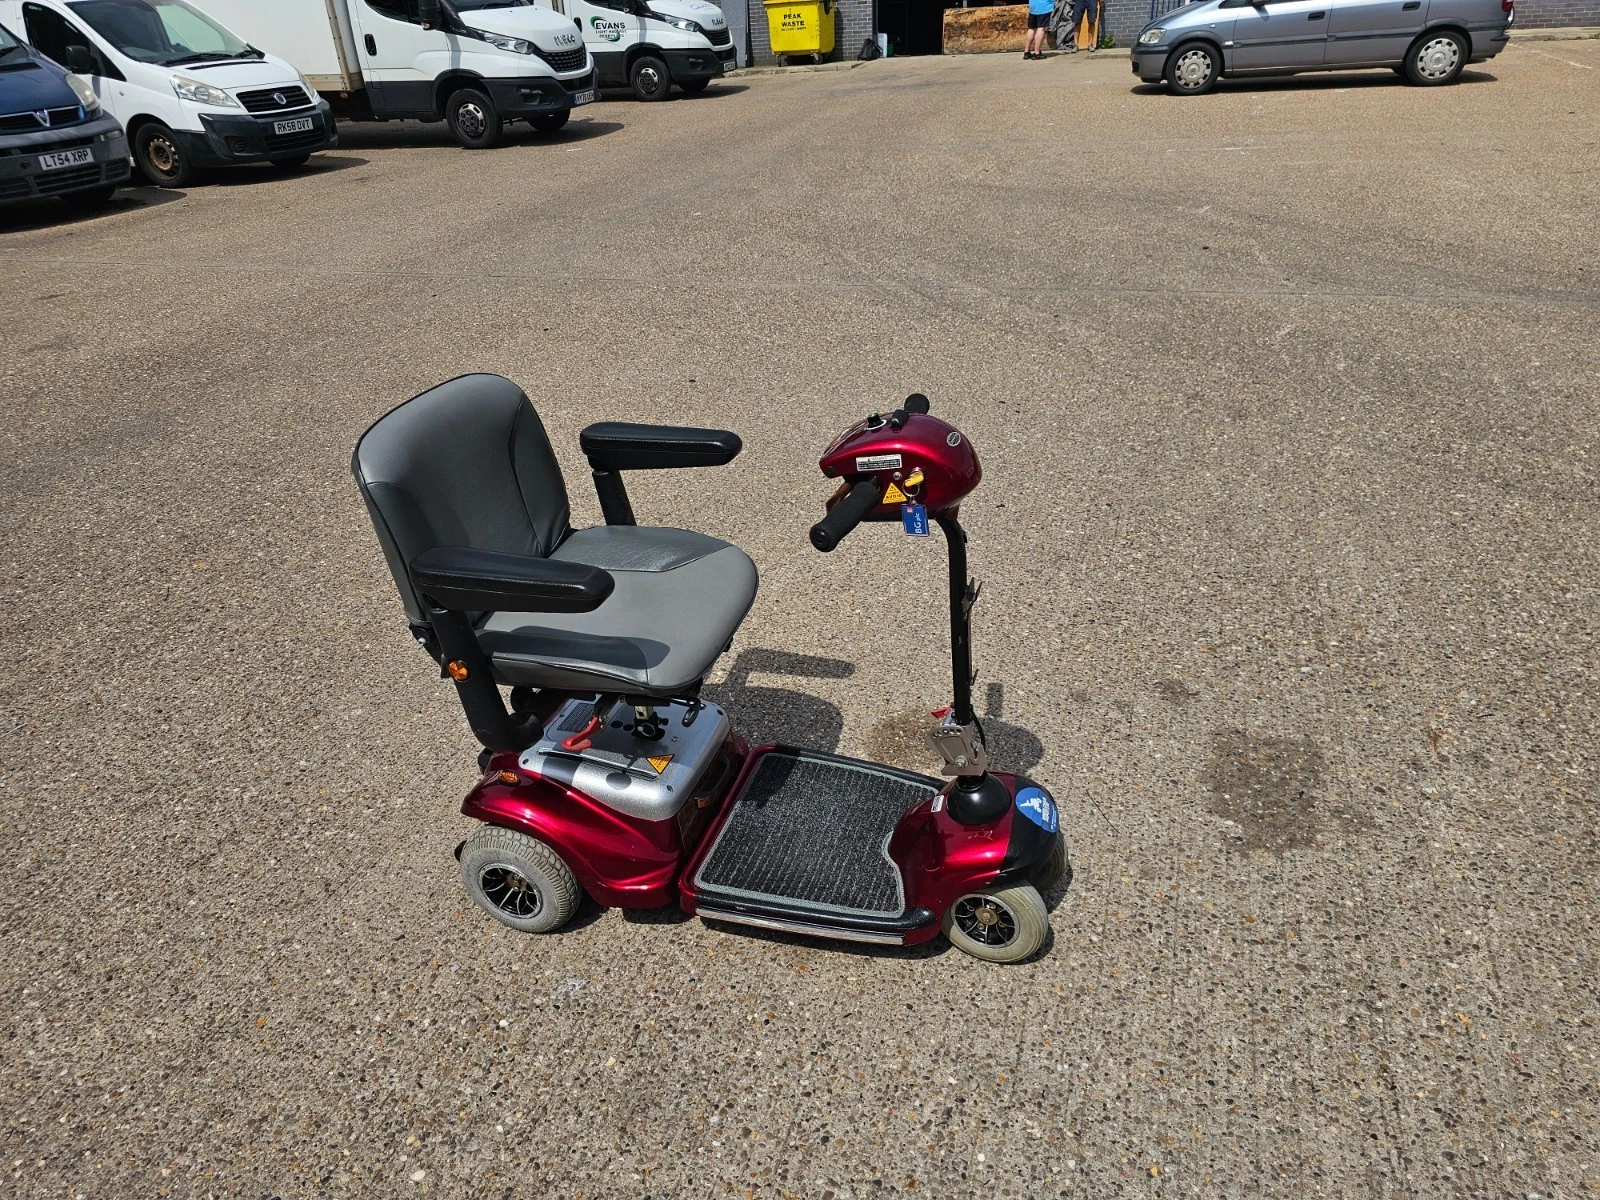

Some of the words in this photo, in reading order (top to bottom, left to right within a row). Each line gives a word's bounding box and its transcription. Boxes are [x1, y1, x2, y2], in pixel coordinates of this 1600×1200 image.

[277, 121, 297, 133] RK58
[297, 119, 310, 130] OVT
[43, 153, 71, 168] LT54
[71, 150, 89, 163] XRP
[914, 522, 922, 534] BG
